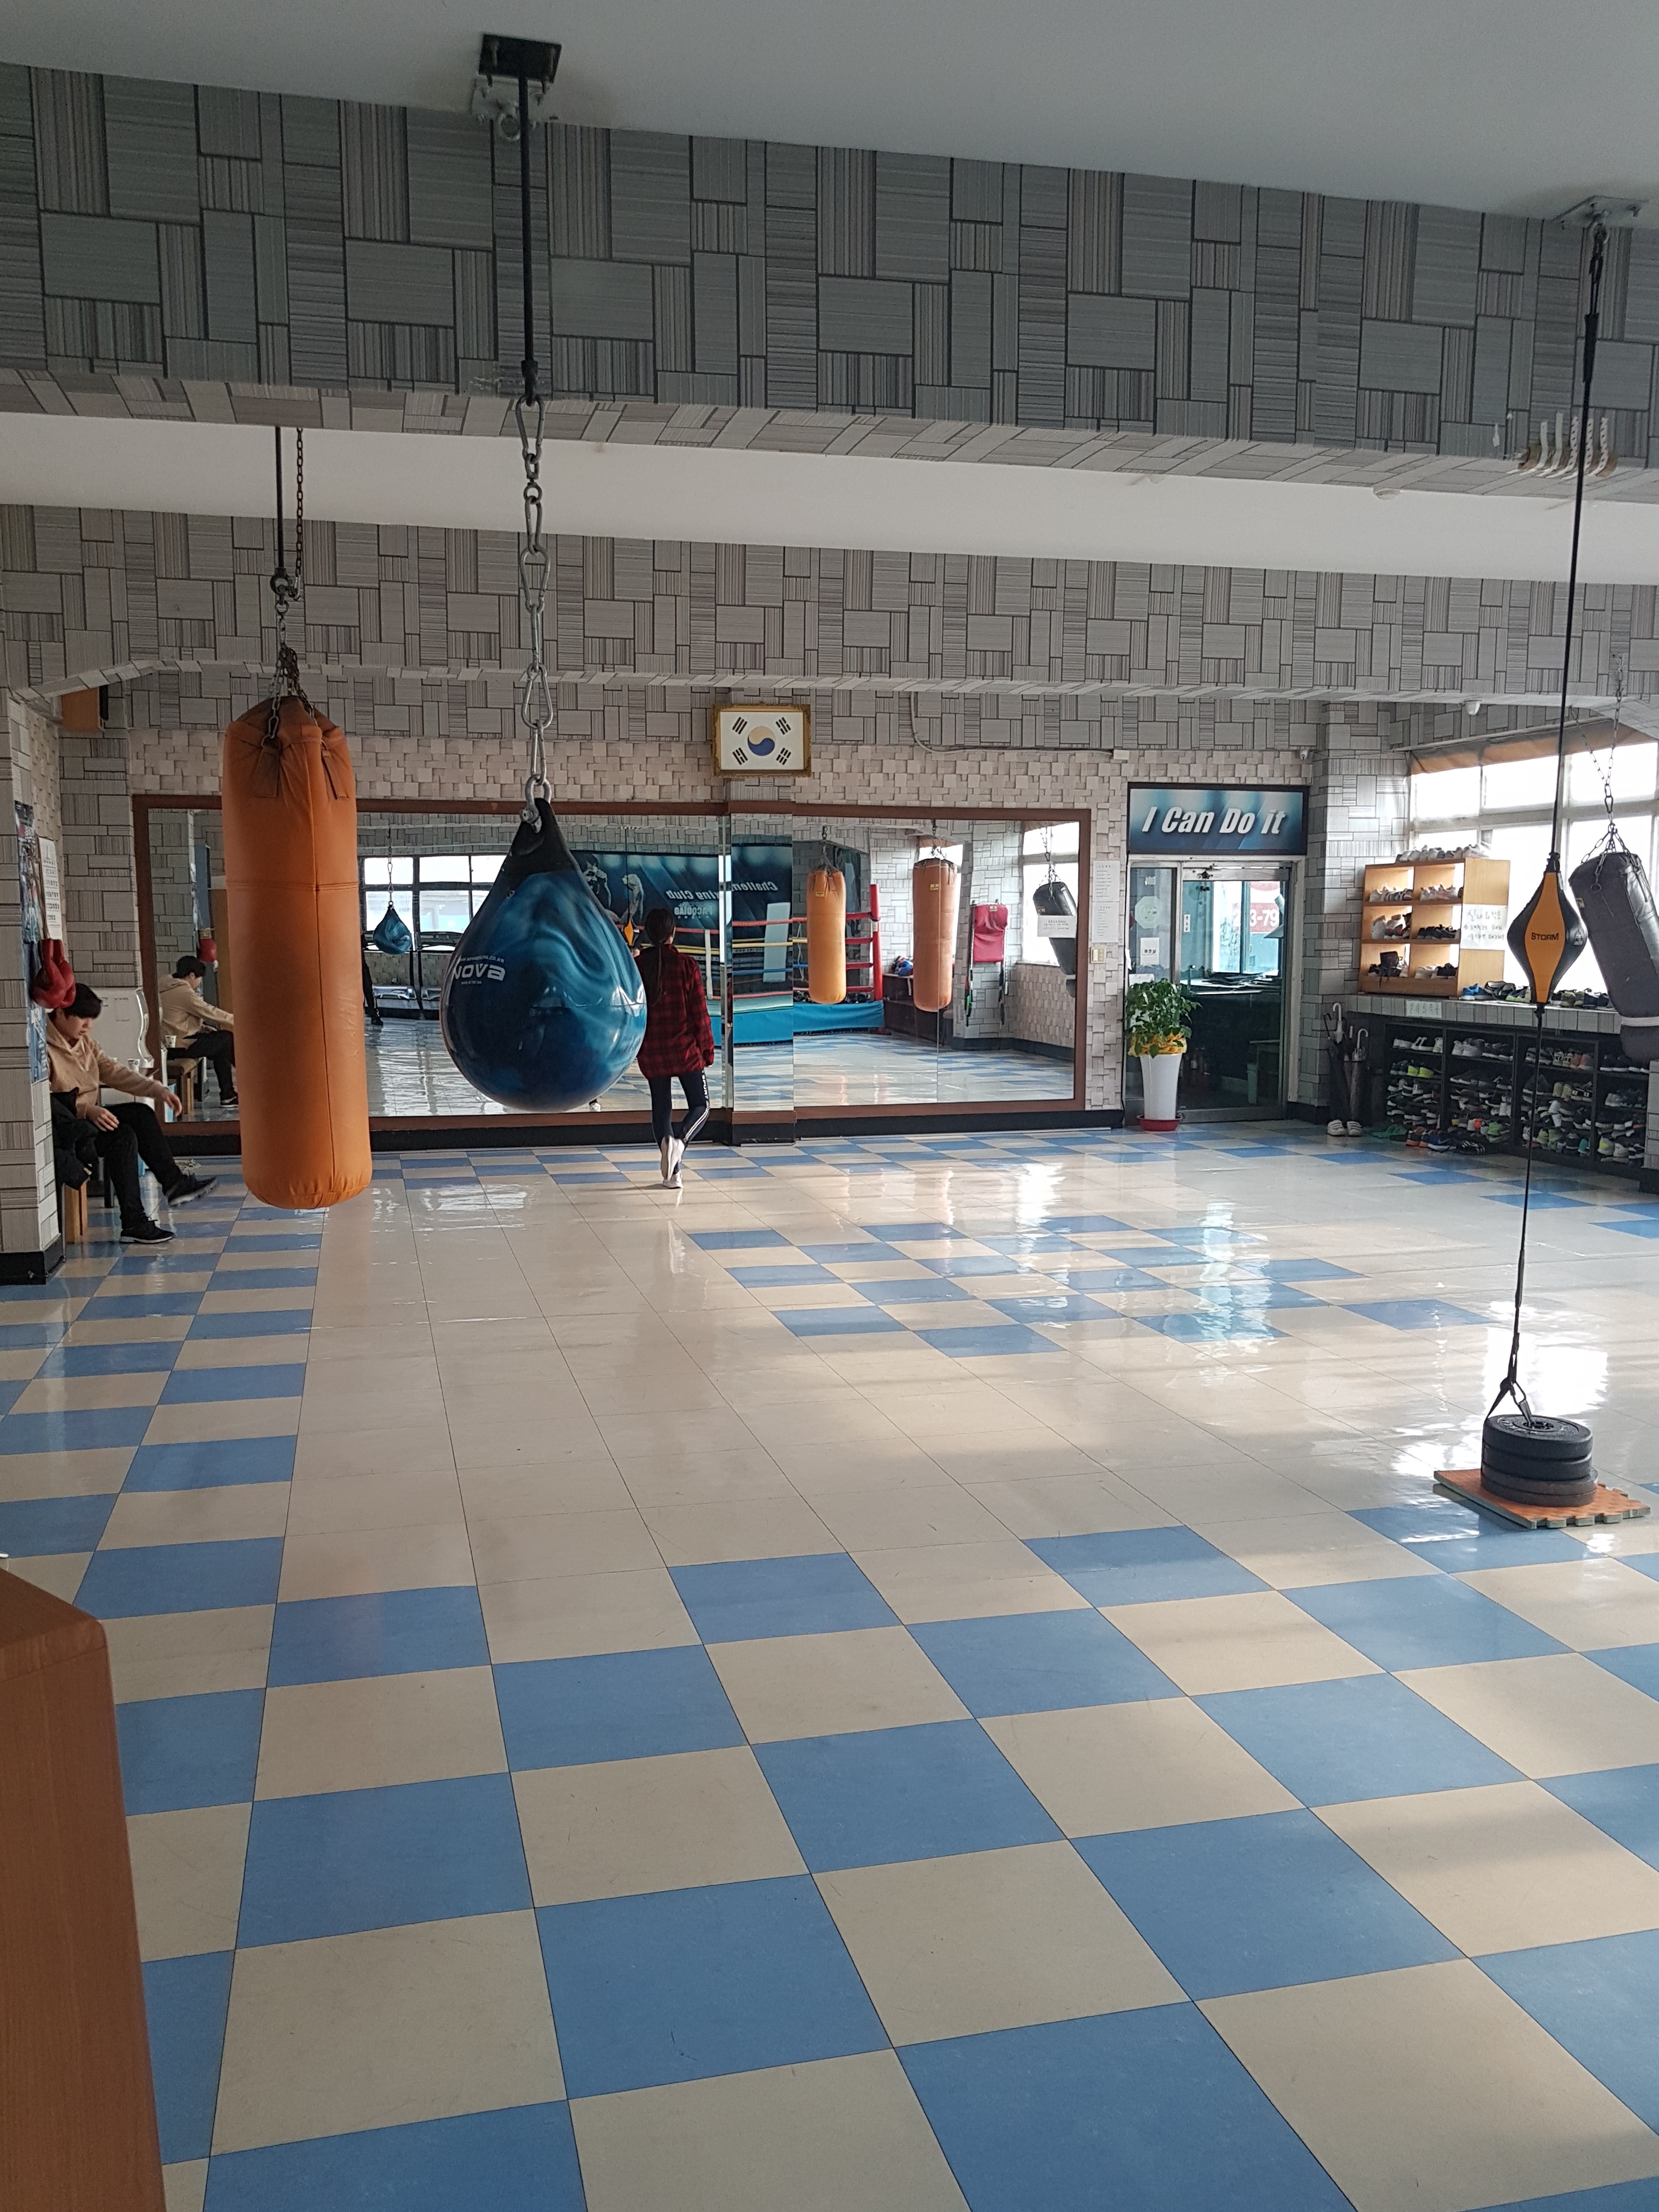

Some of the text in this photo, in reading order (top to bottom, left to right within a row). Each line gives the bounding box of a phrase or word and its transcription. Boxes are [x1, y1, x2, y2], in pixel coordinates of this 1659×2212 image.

[1142, 806, 1286, 834] I Can Do it
[1232, 909, 1279, 927] 23-79
